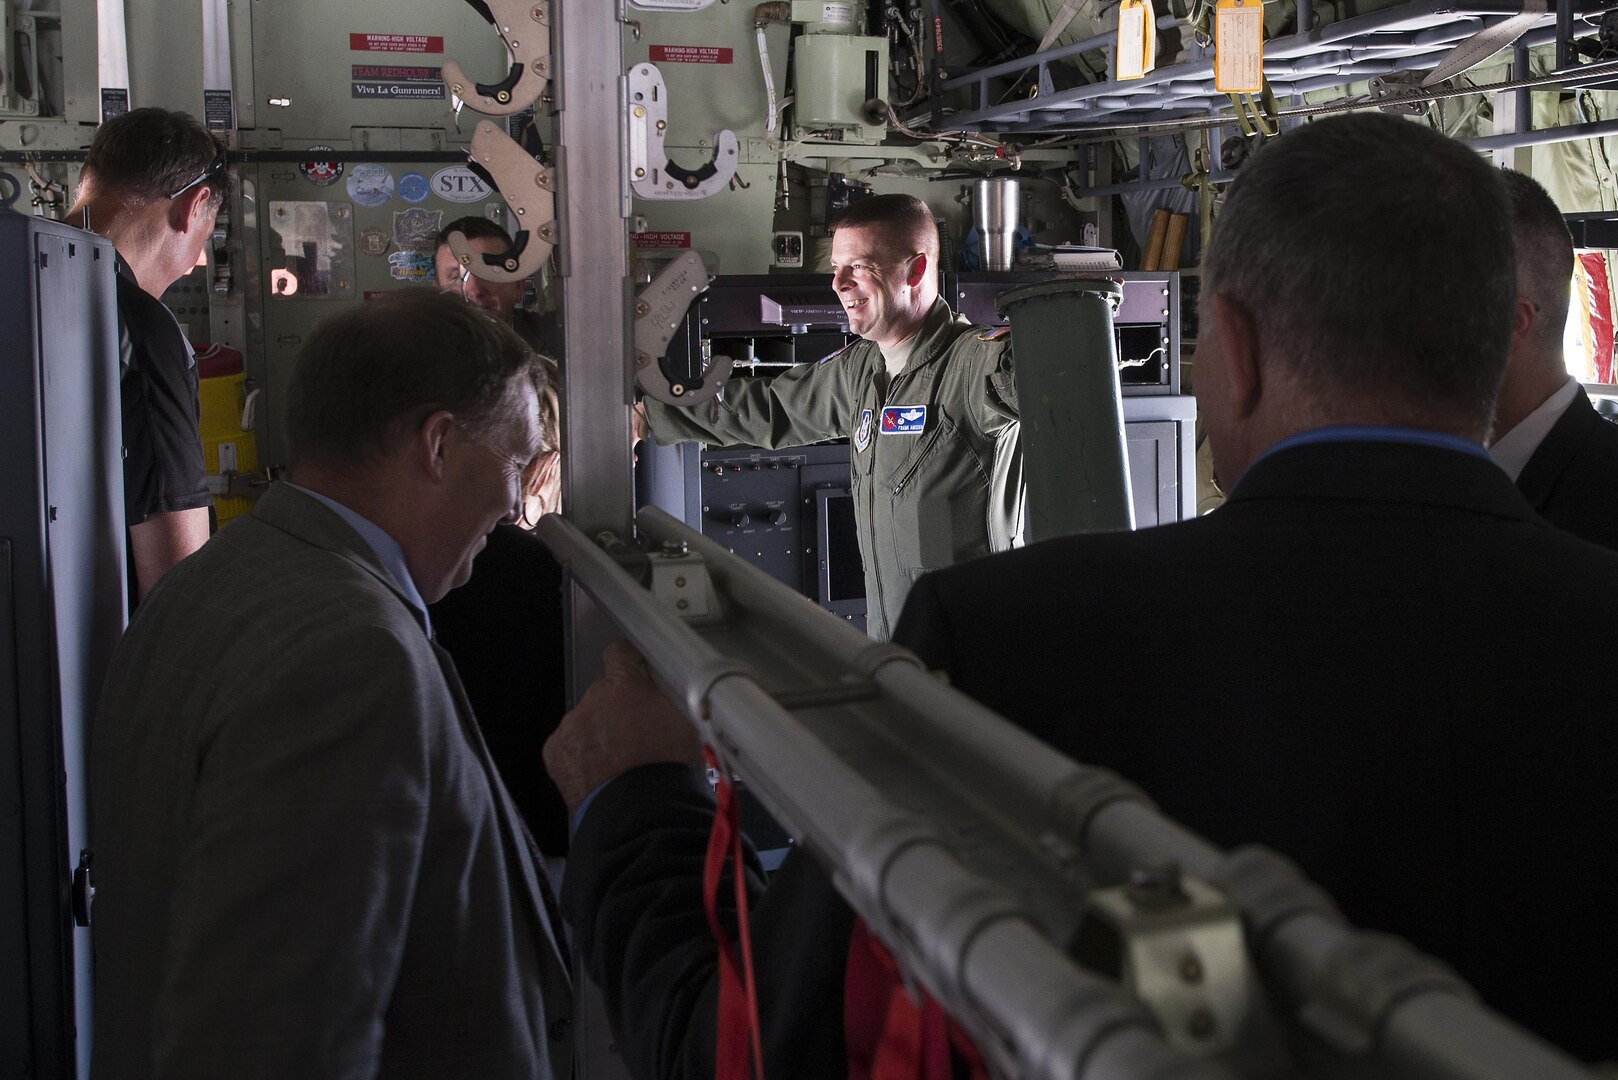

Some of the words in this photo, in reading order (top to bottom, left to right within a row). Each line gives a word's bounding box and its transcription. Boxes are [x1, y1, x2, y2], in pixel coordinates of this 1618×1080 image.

[352, 66, 378, 76] TEAM
[356, 85, 375, 94] Viva
[377, 86, 389, 94] La
[390, 86, 441, 95] Gunrunners!
[440, 175, 484, 193] STX
